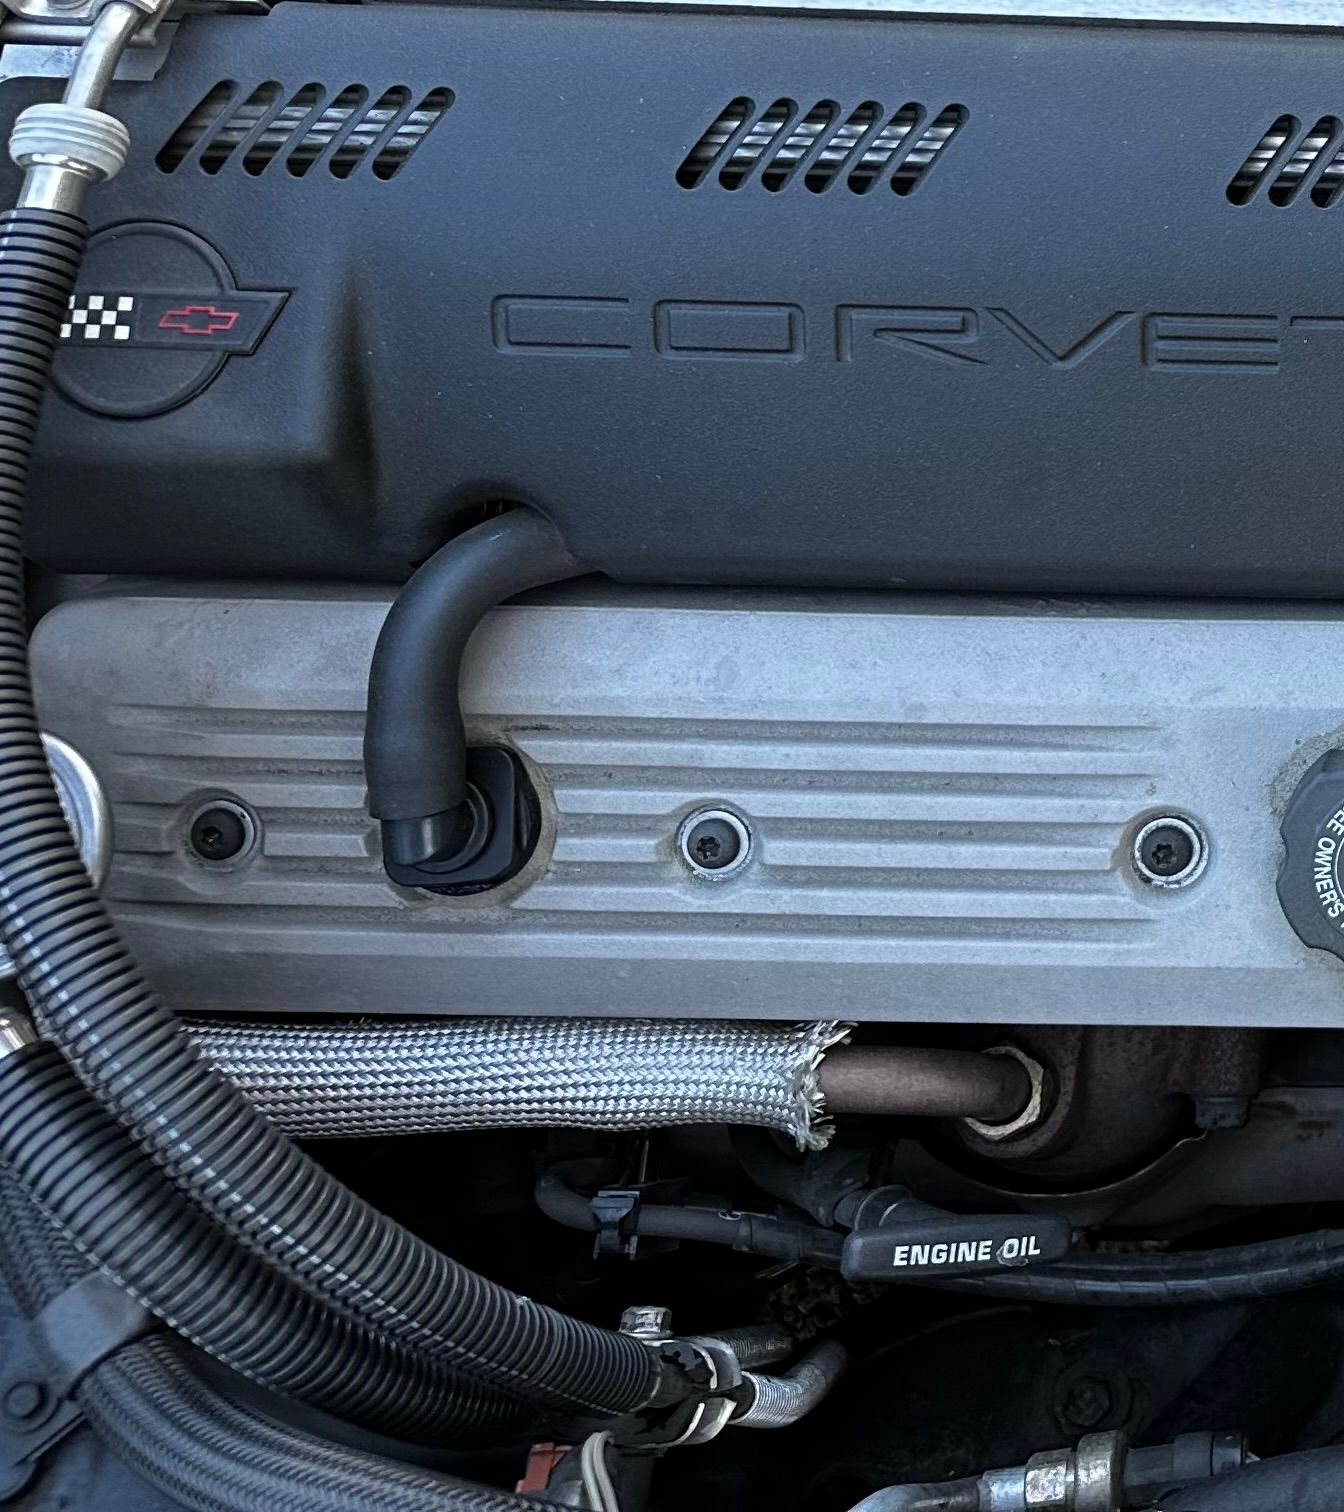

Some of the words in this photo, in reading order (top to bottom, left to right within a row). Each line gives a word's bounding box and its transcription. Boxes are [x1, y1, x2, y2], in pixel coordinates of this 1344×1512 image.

[1314, 837, 1344, 918] OWNER'S
[892, 1239, 993, 1267] ENGINE
[1001, 1235, 1041, 1259] OIL
